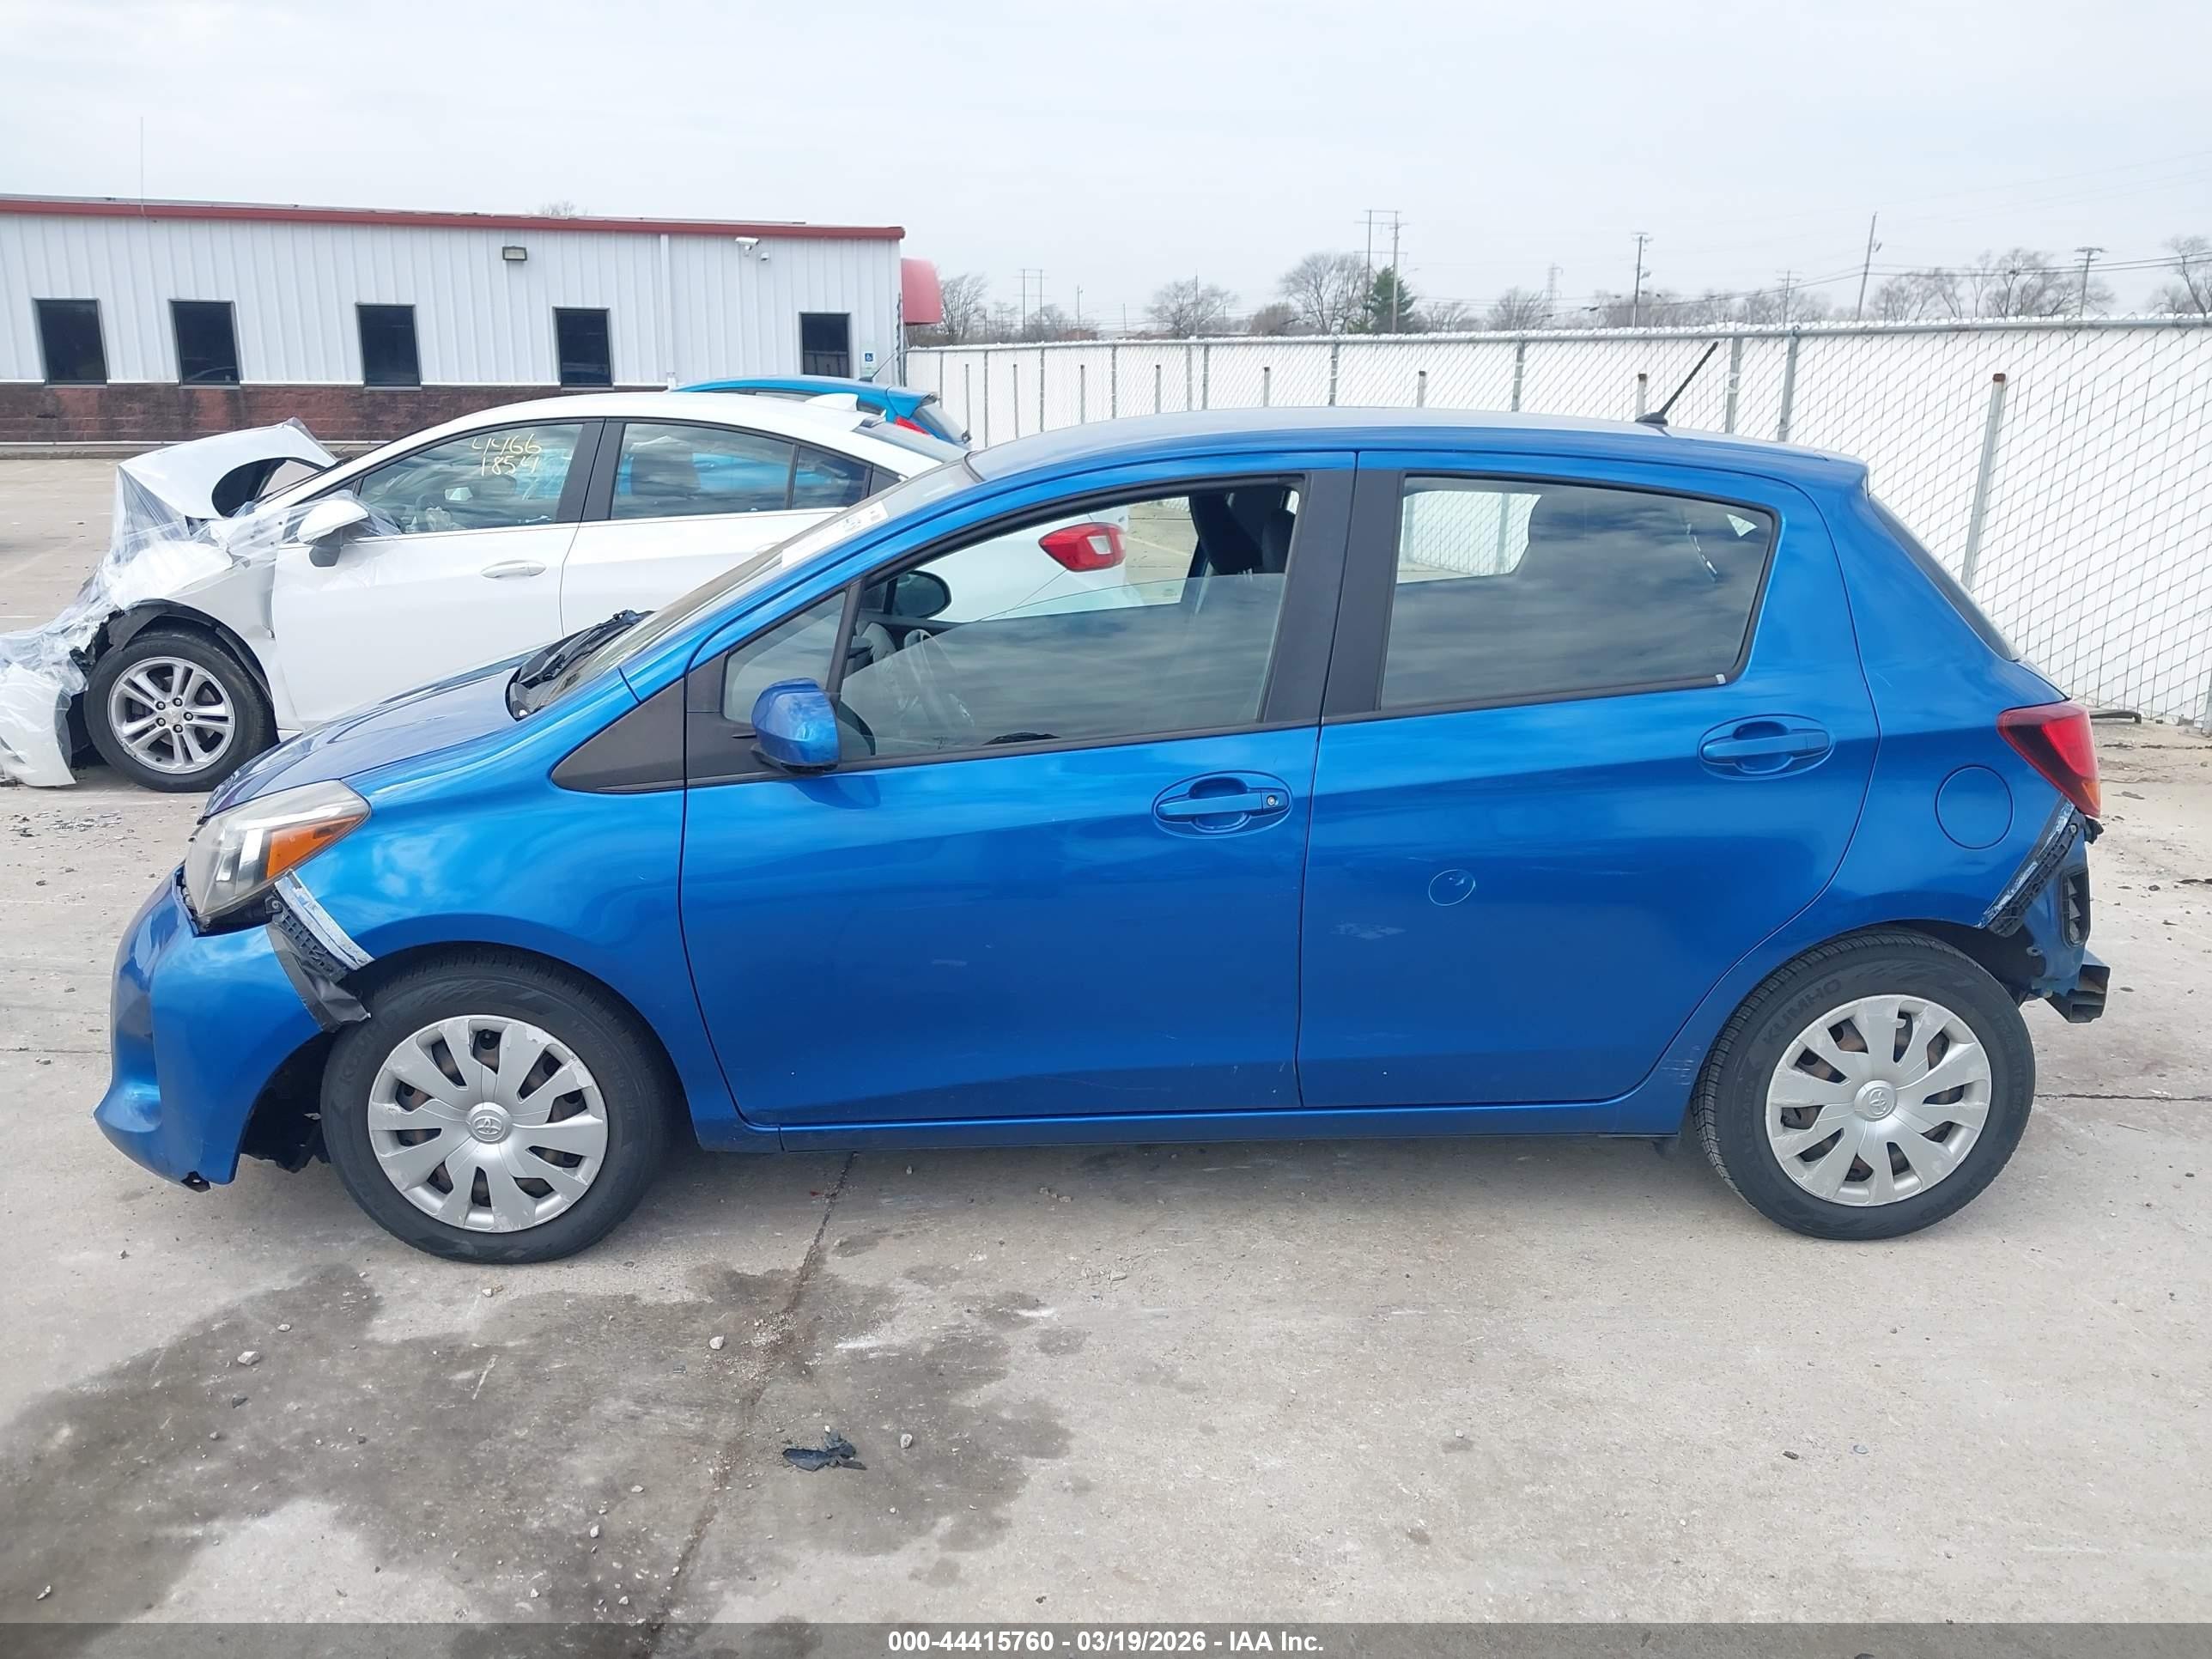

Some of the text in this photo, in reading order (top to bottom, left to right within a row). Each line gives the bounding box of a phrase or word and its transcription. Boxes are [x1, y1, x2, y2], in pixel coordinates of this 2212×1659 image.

[471, 433, 543, 456] 4466
[481, 455, 541, 477] 1854
[1763, 979, 1842, 1044] KUMHO
